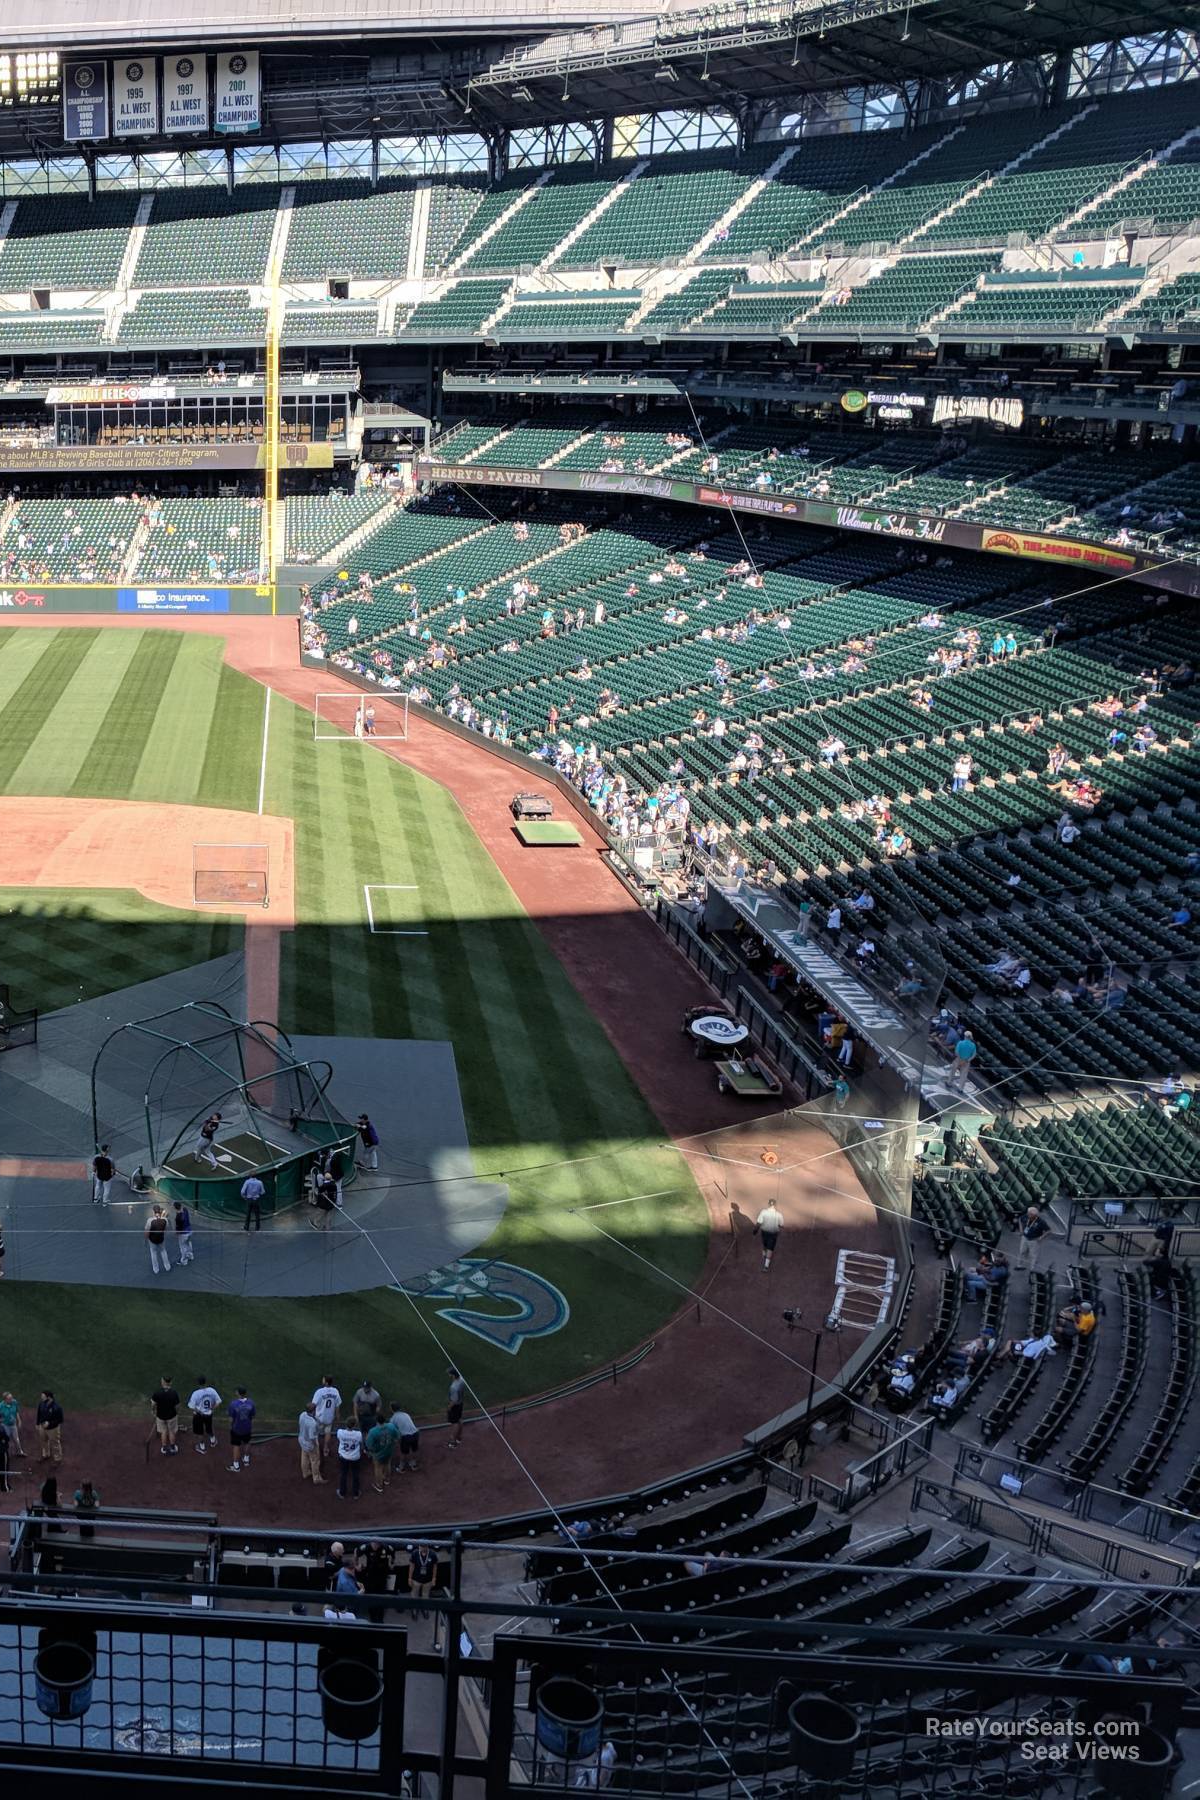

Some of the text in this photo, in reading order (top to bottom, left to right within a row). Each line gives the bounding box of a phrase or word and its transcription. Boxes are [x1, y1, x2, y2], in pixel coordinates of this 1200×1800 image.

[177, 84, 193, 96] 1997
[229, 80, 246, 91] 2001
[127, 88, 144, 99] 1995
[183, 98, 201, 110] WEST
[235, 95, 253, 106] WEST
[132, 102, 151, 114] WEST
[166, 114, 206, 128] CHAMPIONS
[218, 110, 257, 123] CHAMPIONS
[116, 117, 156, 131] CHAMPIONS
[990, 398, 1024, 428] CLUB
[7, 451, 29, 460] about
[56, 450, 88, 460] Reviving
[89, 450, 125, 459] Baseball
[133, 449, 180, 459] Inner-Cities
[182, 449, 220, 459] Program,
[9, 460, 37, 468] Rainier
[38, 459, 57, 468] Vista
[58, 459, 77, 469] Boys
[86, 458, 105, 467] Girls
[106, 458, 124, 467] Club
[431, 467, 542, 484] HENRY'S TAVERN
[837, 507, 946, 541] Welcome to Safeco Field
